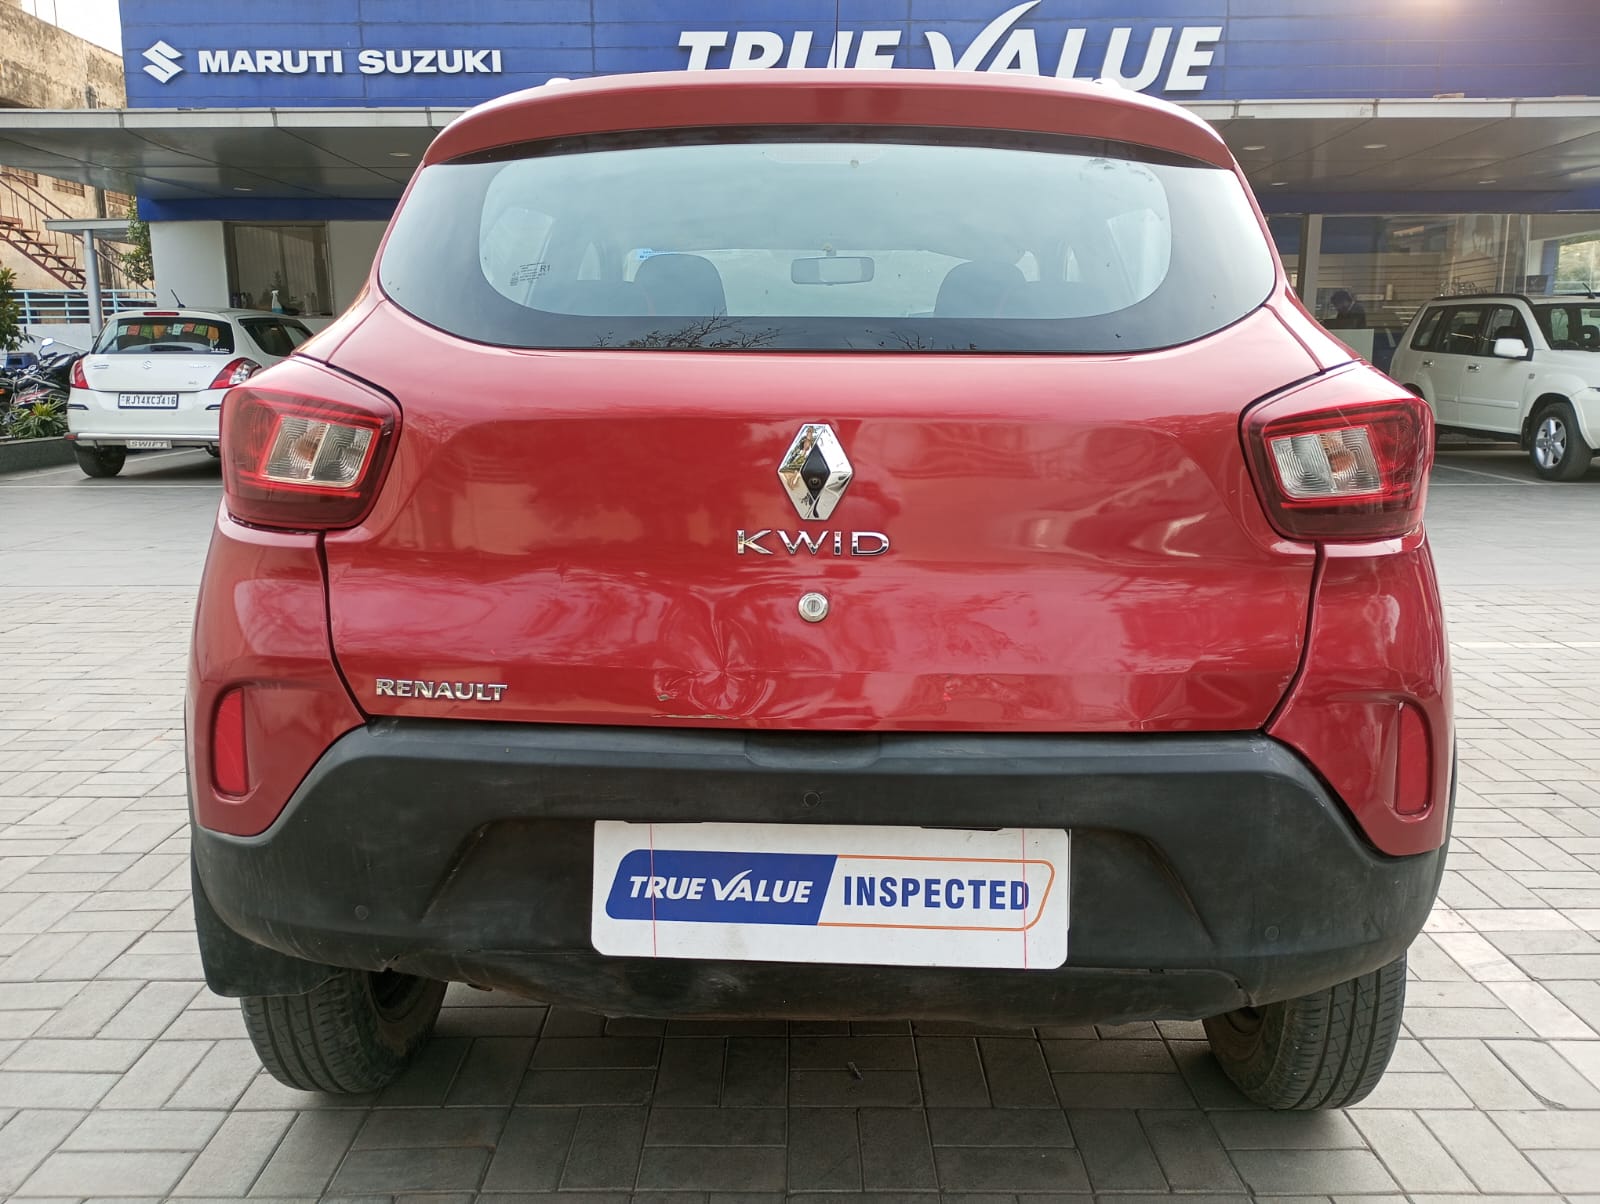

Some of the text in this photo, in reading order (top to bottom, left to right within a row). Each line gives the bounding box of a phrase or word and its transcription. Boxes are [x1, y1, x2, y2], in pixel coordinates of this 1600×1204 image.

[924, 0, 1223, 92] VALUE
[199, 49, 502, 75] MARUTI SUZUKI
[736, 529, 890, 556] KWID
[375, 678, 508, 701] RENAULT
[629, 869, 1030, 911] TRUE VALUE INSPECTED
